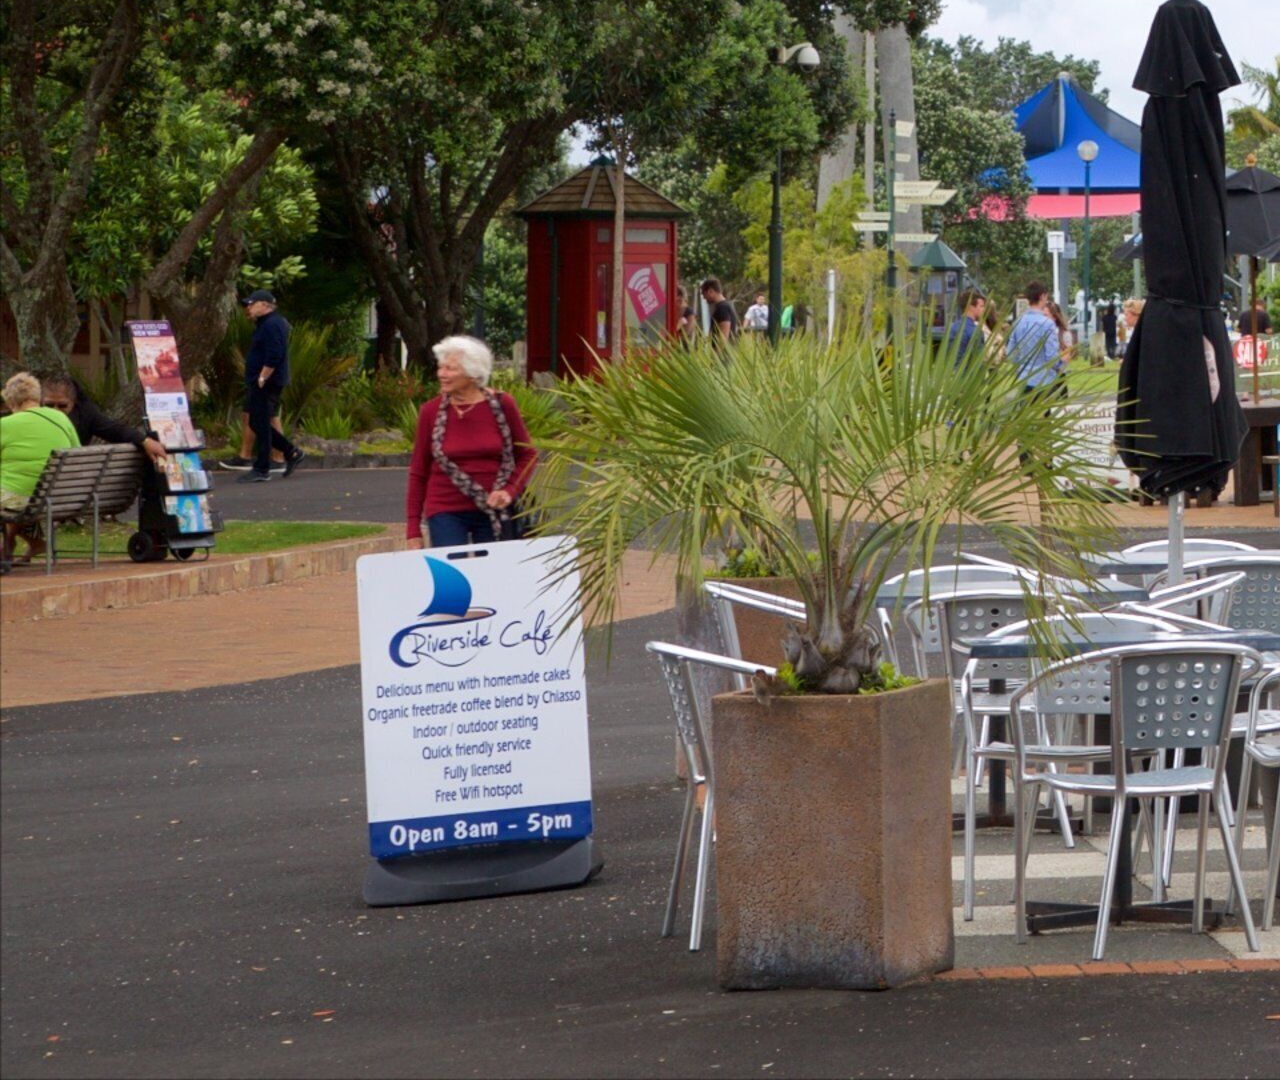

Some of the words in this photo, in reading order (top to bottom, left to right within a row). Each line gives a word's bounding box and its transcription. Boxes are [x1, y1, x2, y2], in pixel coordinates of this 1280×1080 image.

[405, 622, 492, 656] Riverside
[376, 685, 422, 699] Delicious
[425, 681, 454, 694] menu
[457, 677, 481, 691] with
[483, 672, 540, 688] homemade
[543, 668, 571, 682] cakes
[368, 706, 409, 724] Organic
[412, 702, 457, 717] freetrade
[460, 698, 492, 712] coffee
[494, 694, 524, 709] blend
[526, 692, 540, 709] by
[542, 689, 581, 704] Chiasso
[413, 724, 448, 739] Indoor
[449, 722, 455, 737] /
[457, 719, 499, 735] outdoor
[501, 715, 538, 731] seating
[422, 745, 453, 760] Quick
[455, 741, 494, 758] friendly
[496, 737, 532, 752] service
[443, 764, 469, 781] Fully
[471, 761, 512, 777] licensed
[435, 788, 457, 803] Free
[460, 784, 480, 801] Wifi
[482, 782, 523, 800] hotspot
[389, 824, 445, 851] Open
[453, 820, 498, 840] 8am
[527, 813, 573, 837] 5pm
